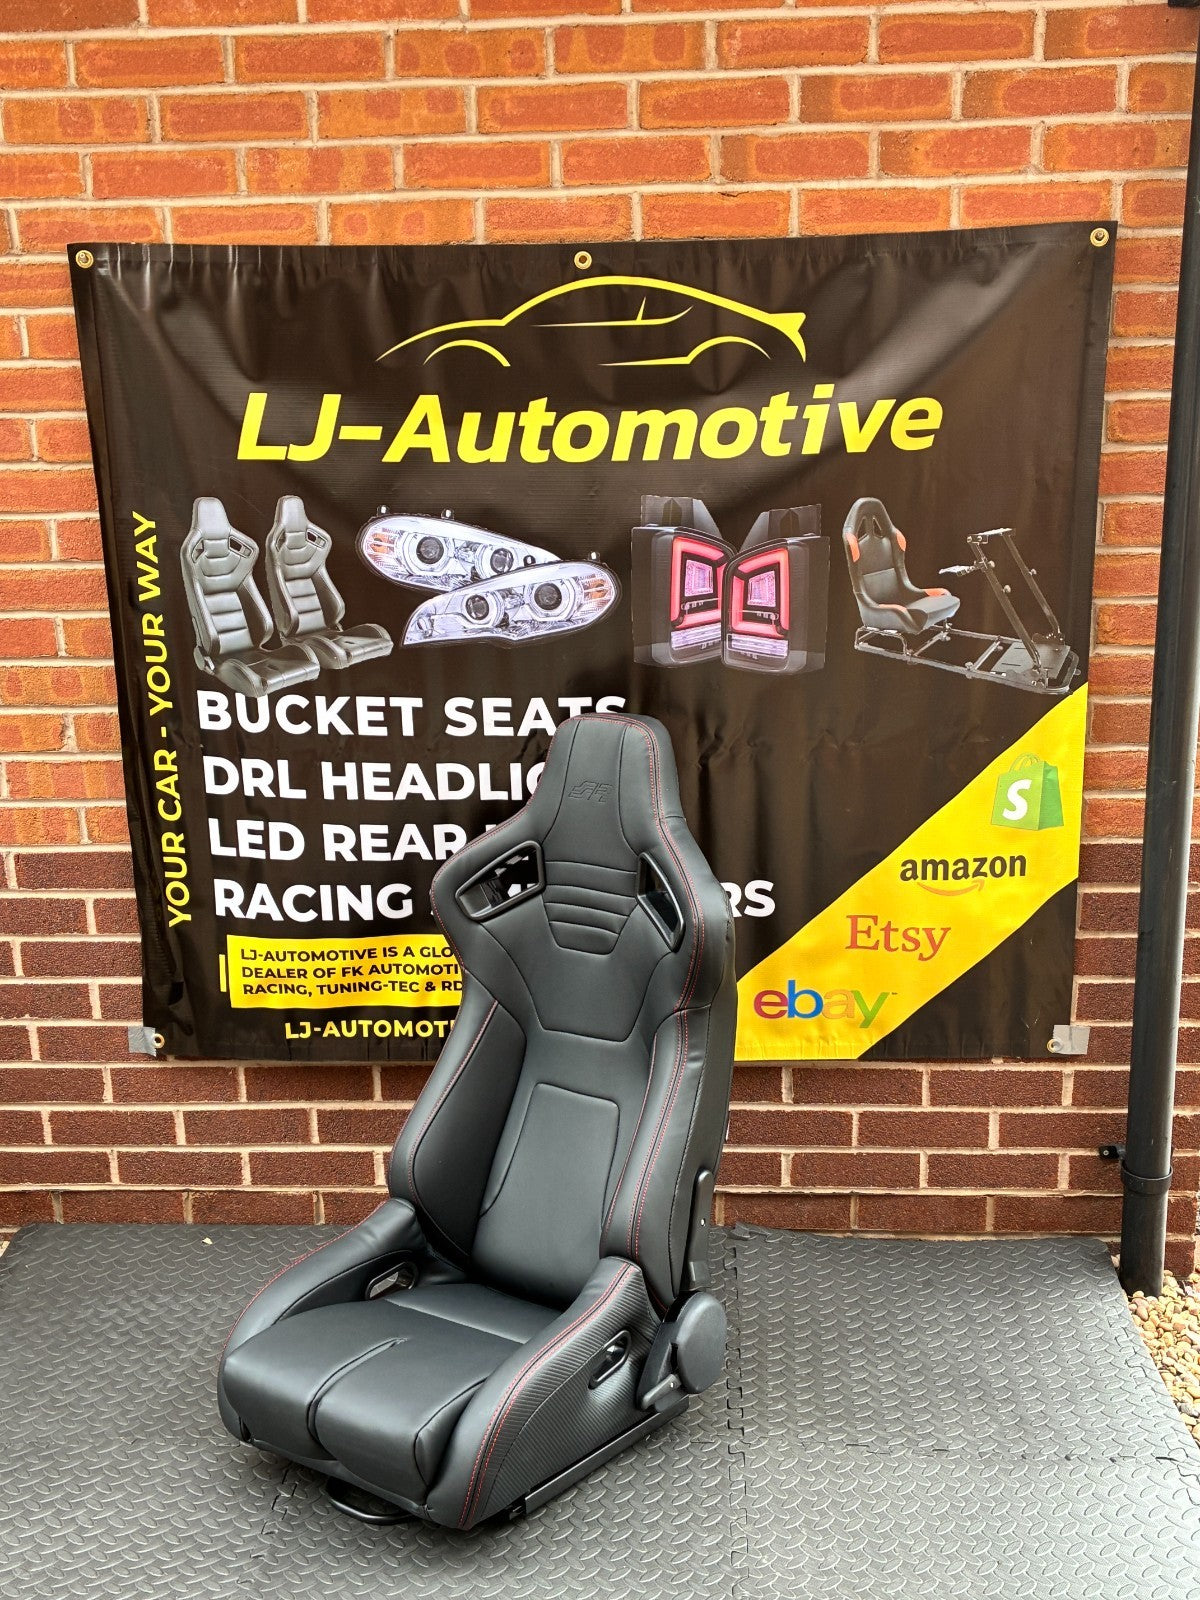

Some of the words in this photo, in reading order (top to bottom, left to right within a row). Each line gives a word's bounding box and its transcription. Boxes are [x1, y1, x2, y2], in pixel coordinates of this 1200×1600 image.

[237, 384, 943, 464] LJ-Automotive
[132, 511, 161, 601] WAY
[142, 613, 173, 716] YOUR
[197, 690, 423, 736] BUCKET
[153, 749, 182, 822] CAR
[203, 755, 307, 799] DRL
[208, 818, 305, 861] LED
[322, 823, 467, 862] REAR
[161, 831, 192, 928] YOUR
[900, 854, 1027, 881] amazon
[213, 878, 413, 923] RACING
[240, 947, 377, 962] LJ-AUTOMOTIVE
[383, 946, 398, 958] IS
[403, 946, 415, 958] A
[419, 946, 455, 958] GLO
[845, 915, 951, 961] Etsy
[242, 966, 308, 979] DEALER
[313, 967, 336, 979] OF
[341, 966, 363, 977] FK
[368, 963, 459, 976] AUTOMOTI
[243, 983, 313, 997] RACING,
[316, 980, 420, 995] TUNING-TEC
[425, 981, 436, 992] &
[441, 980, 463, 991] RD
[753, 980, 890, 1029] ebay
